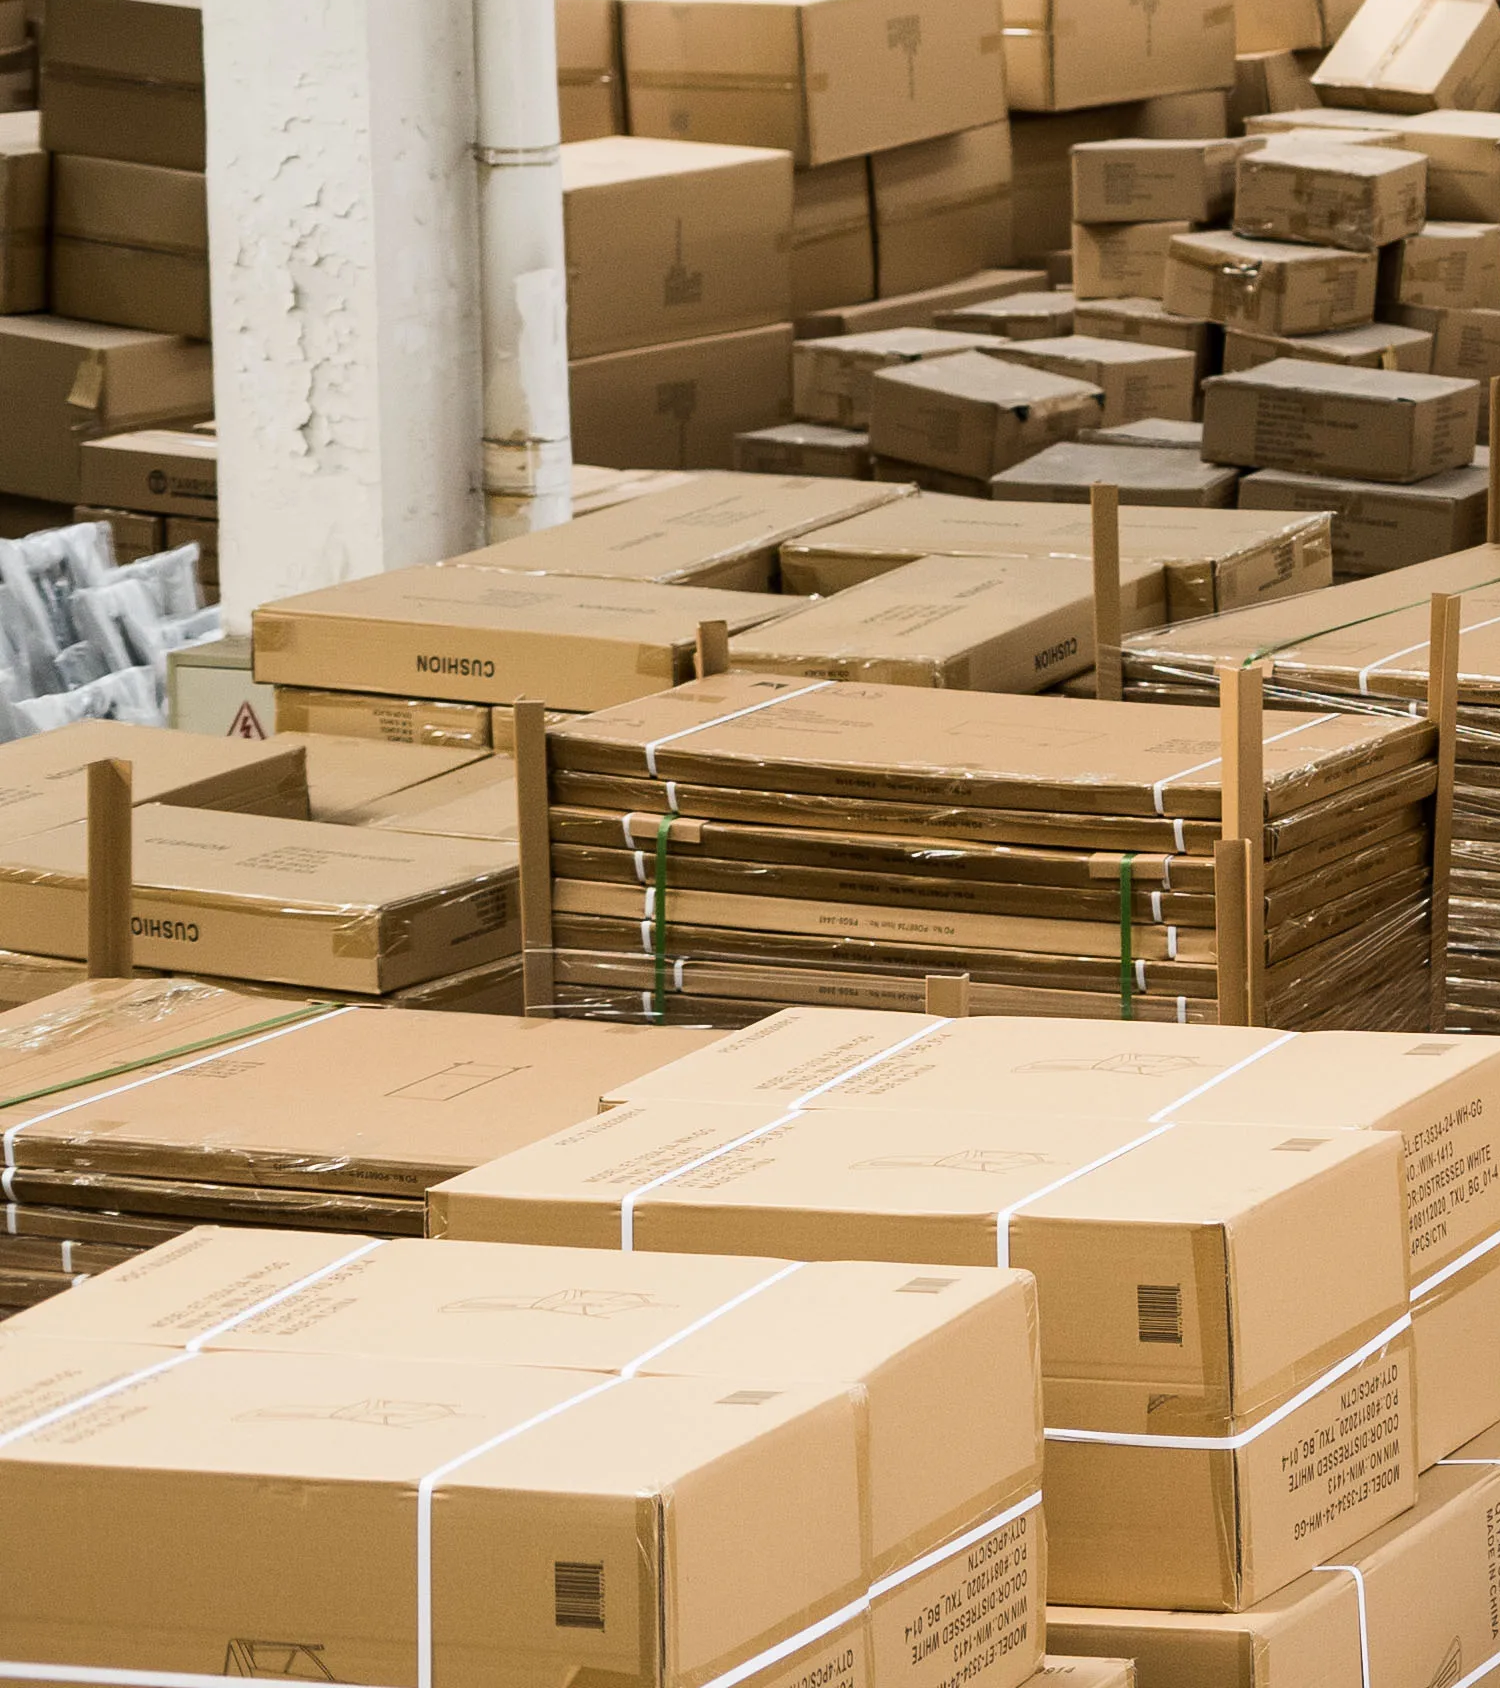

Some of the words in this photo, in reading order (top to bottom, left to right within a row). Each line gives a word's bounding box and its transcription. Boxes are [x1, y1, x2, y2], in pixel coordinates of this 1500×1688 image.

[417, 655, 494, 677] CUSHION
[1034, 637, 1076, 672] CUSHION
[131, 917, 199, 942] CUSHIO
[1467, 1144, 1491, 1170] WHITE
[1341, 1364, 1398, 1410] QTY:4PCS/CTN
[1317, 1413, 1398, 1476] COLOR:DISTRESSED
[1384, 1440, 1399, 1461] WIN
[1289, 1467, 1315, 1492] WHITE
[1294, 1464, 1399, 1540] MODEL:ET-3534-24-WH-GG
[968, 1518, 1026, 1572] QTY:4PCS/CTN
[1486, 1508, 1495, 1559] MADE
[1489, 1564, 1496, 1581] IN
[943, 1569, 1027, 1644] COLOR:DISTRESSED
[1011, 1596, 1027, 1620] WIN
[1490, 1584, 1499, 1640] CHINA
[912, 1631, 939, 1665] WHITE
